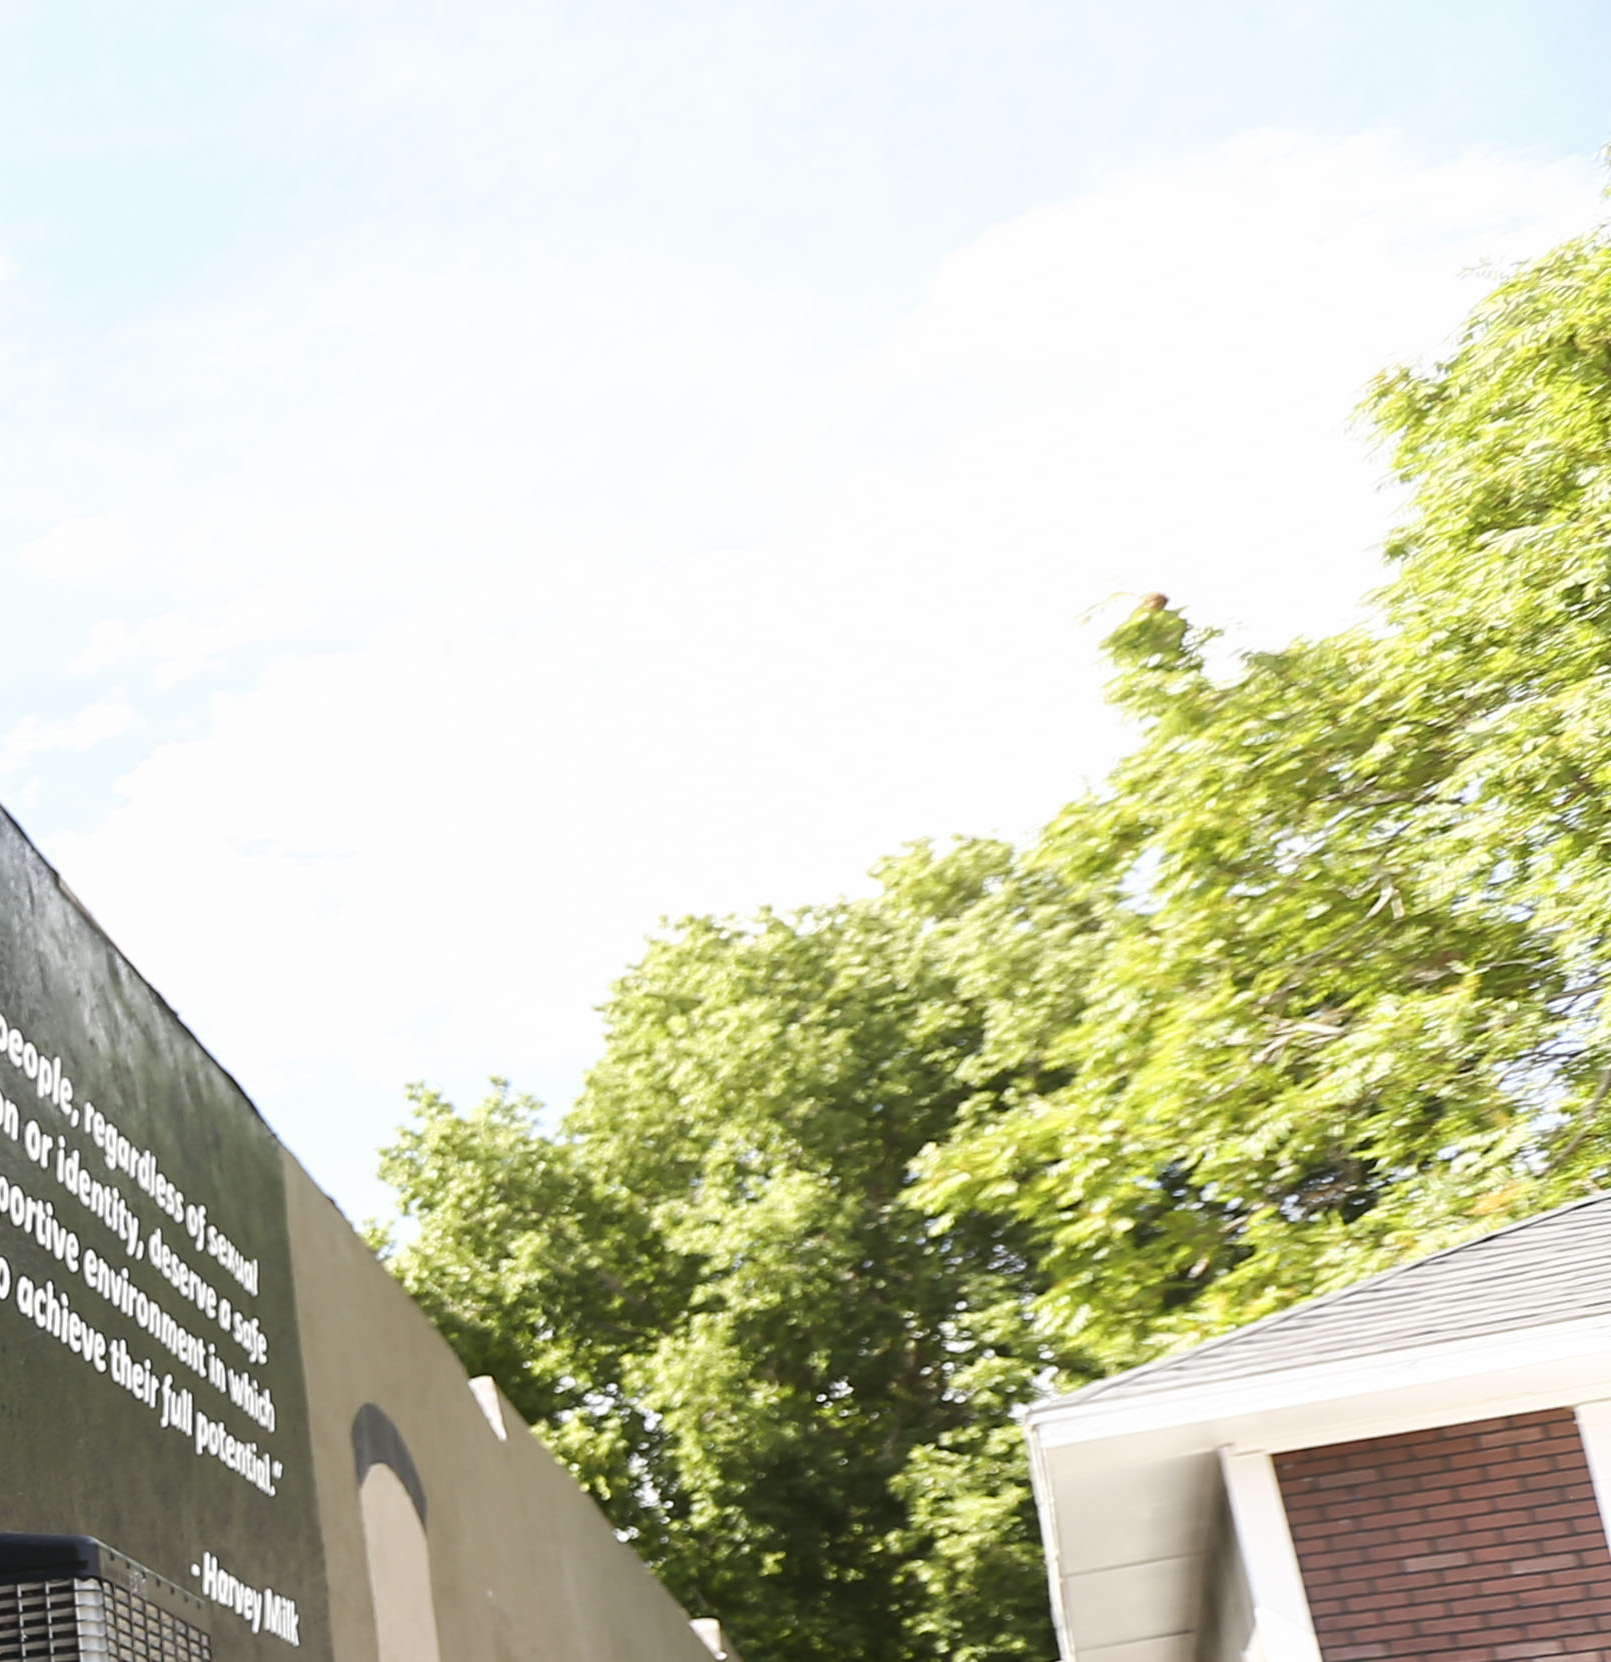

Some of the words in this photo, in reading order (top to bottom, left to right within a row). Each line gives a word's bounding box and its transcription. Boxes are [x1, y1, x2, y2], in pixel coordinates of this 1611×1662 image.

[24, 1120, 53, 1168] or
[56, 1135, 144, 1260] identity,
[148, 1228, 217, 1319] deserve
[218, 1298, 231, 1331] a
[233, 1312, 267, 1364] safe
[84, 1101, 184, 1223] regardless
[186, 1204, 207, 1251] of
[207, 1225, 258, 1296] sexual
[17, 1276, 107, 1372] achieve
[109, 1339, 160, 1408] their
[160, 1374, 193, 1436] full
[83, 1249, 207, 1378] environment
[208, 1343, 227, 1393] in
[227, 1368, 275, 1432] which
[202, 1551, 263, 1634] Harvey
[264, 1588, 300, 1646] Milk
